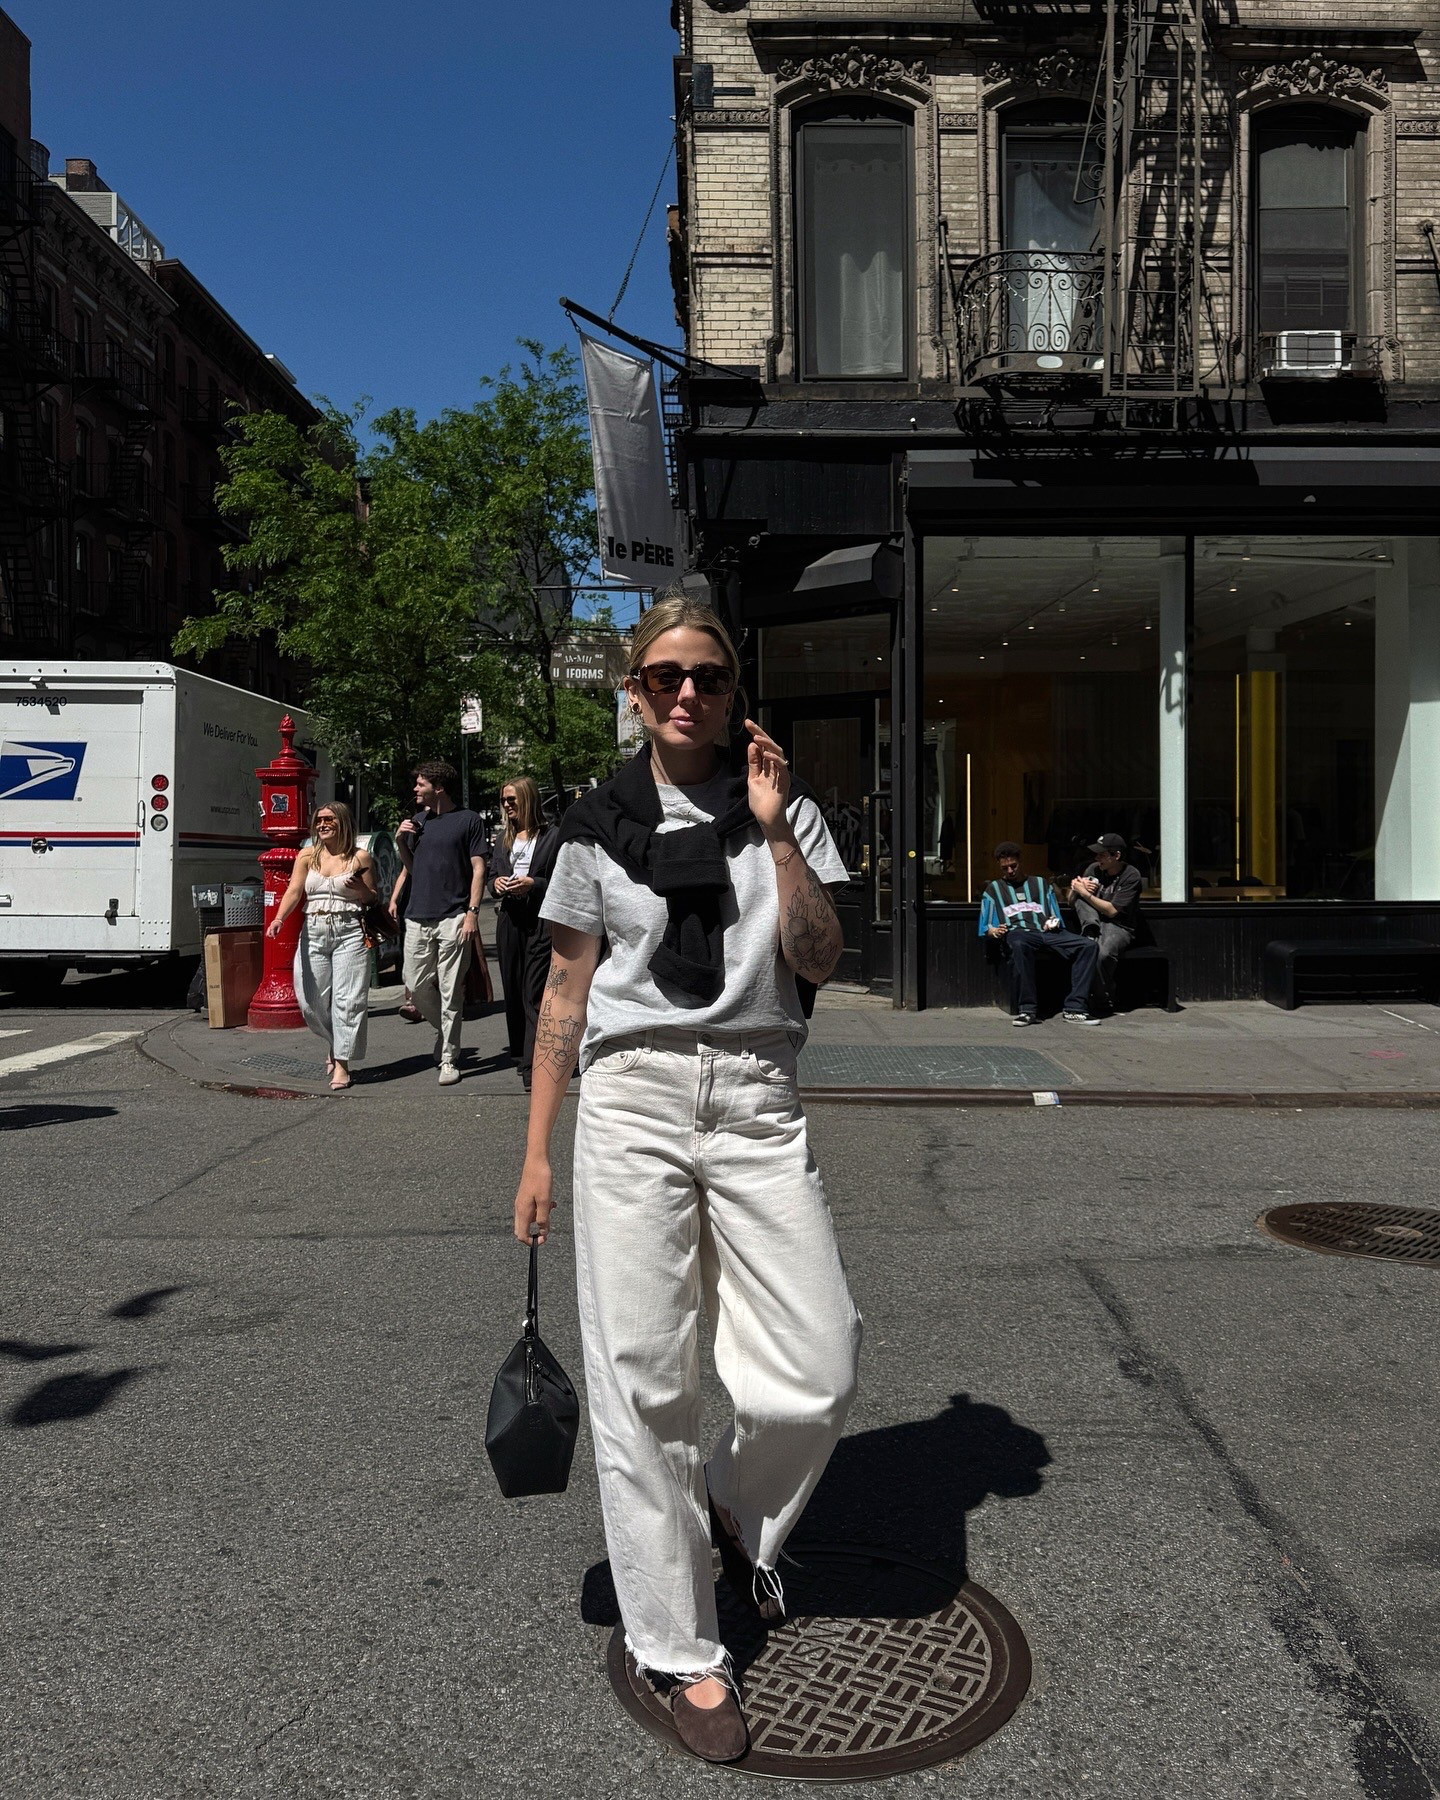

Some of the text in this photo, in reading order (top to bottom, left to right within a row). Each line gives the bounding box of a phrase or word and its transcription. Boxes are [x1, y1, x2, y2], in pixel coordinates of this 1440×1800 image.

[608, 536, 675, 567] le PÈRE
[553, 667, 604, 679] UIFORMS
[15, 696, 68, 707] 7534520
[203, 722, 214, 737] We
[215, 724, 237, 742] Deliver
[237, 730, 247, 744] For
